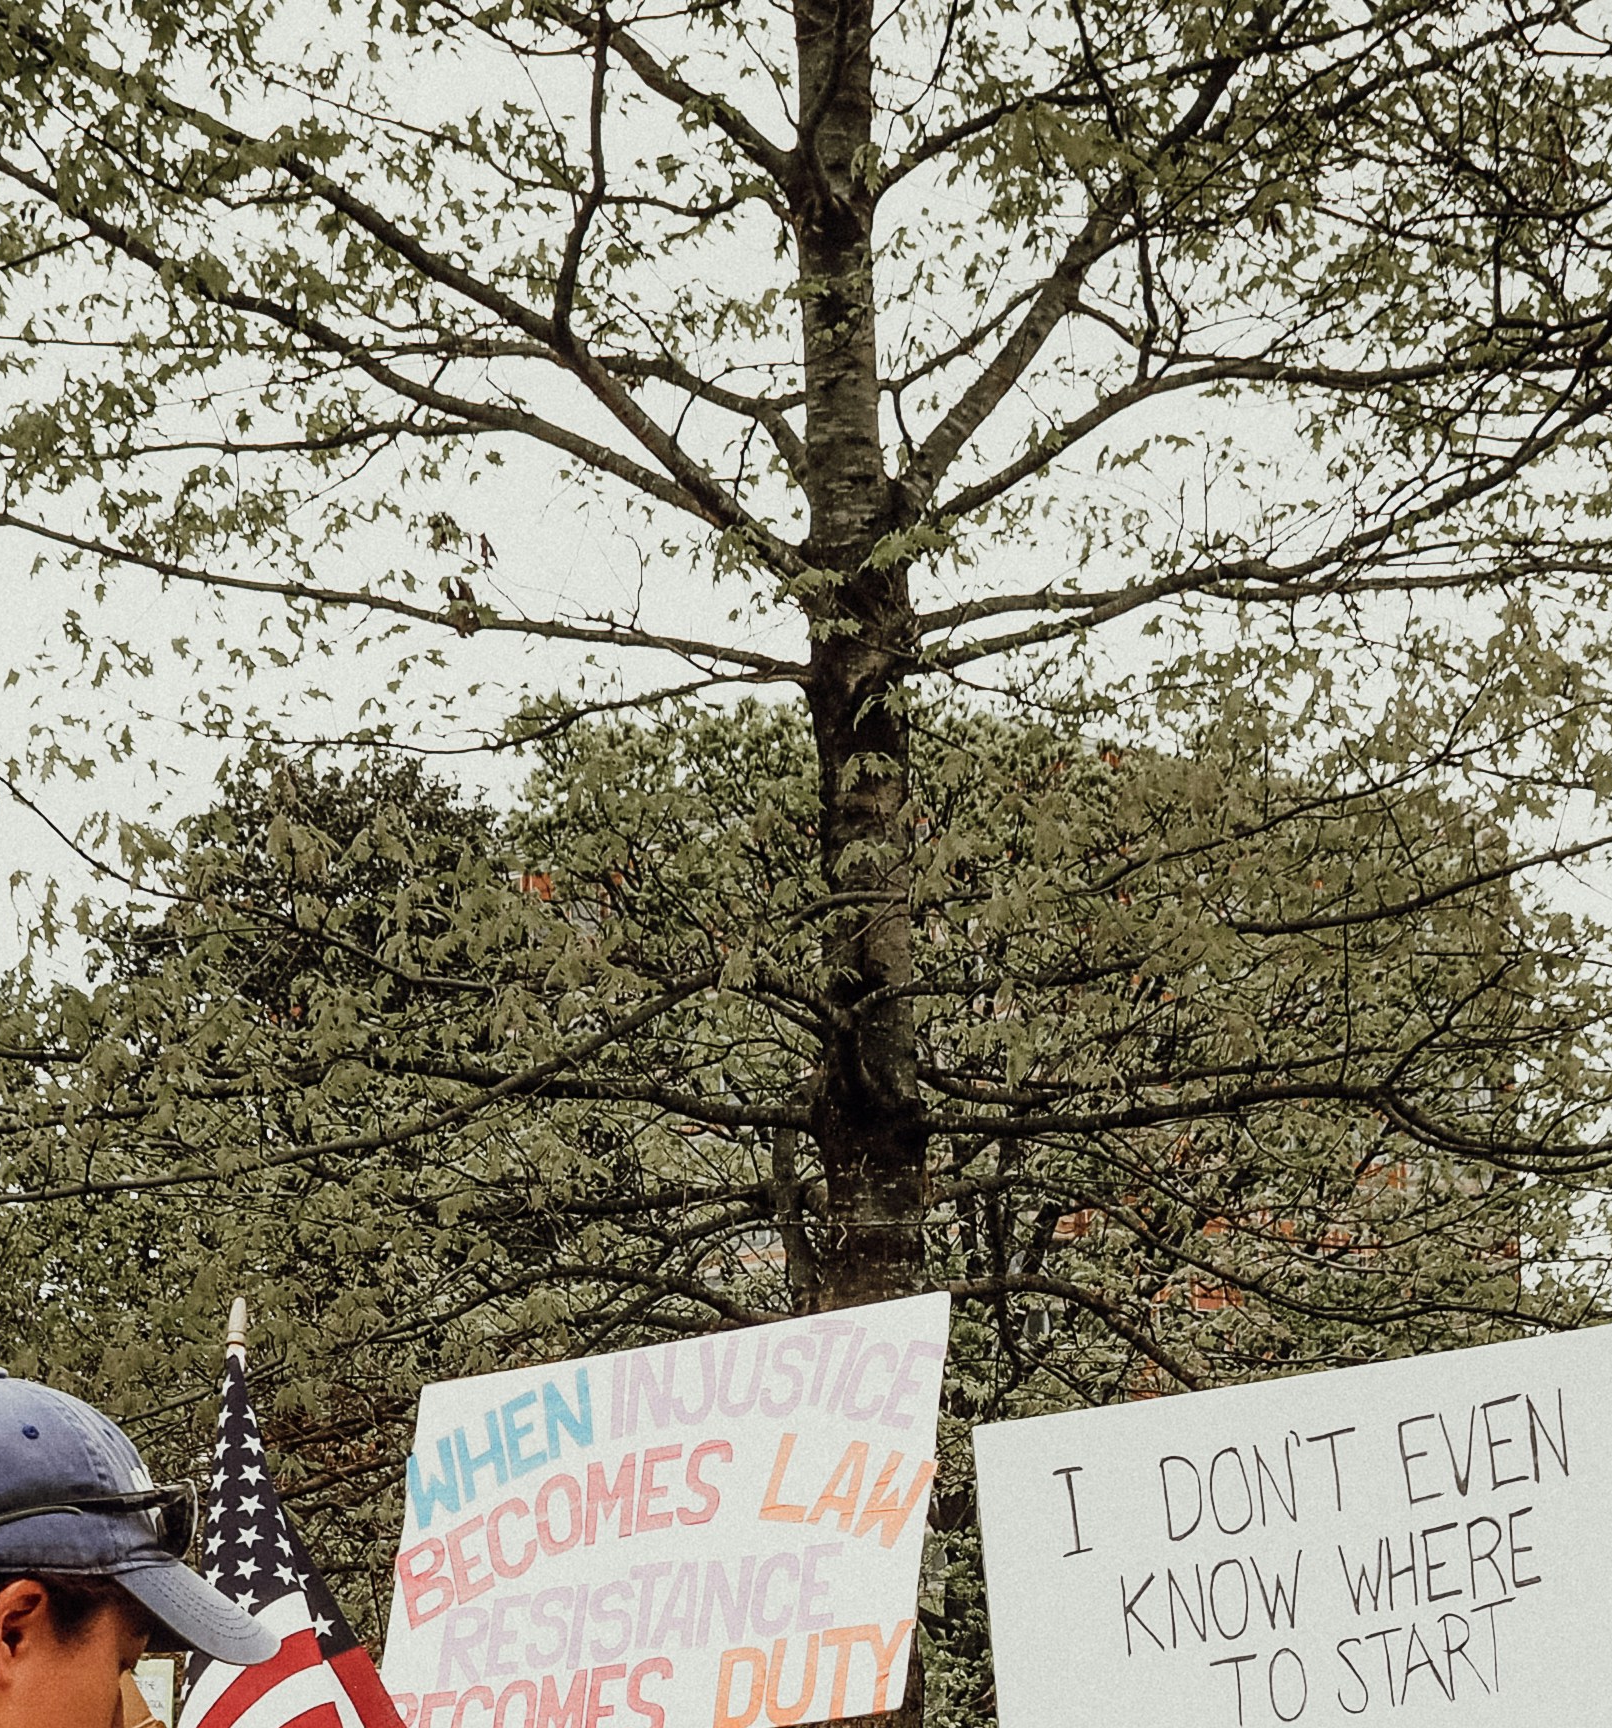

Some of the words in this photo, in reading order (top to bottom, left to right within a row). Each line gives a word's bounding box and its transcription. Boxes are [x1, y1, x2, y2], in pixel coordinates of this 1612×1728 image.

[405, 1366, 595, 1530] WHEN
[609, 1318, 944, 1440] INJUSTICE
[1052, 1465, 1094, 1558] I
[1158, 1426, 1356, 1542] DON'T
[1397, 1387, 1570, 1506] EVEN
[395, 1439, 733, 1631] BECOMES
[757, 1432, 938, 1549] LAW
[1119, 1548, 1303, 1657] KNOW
[1337, 1505, 1542, 1616] WHERE
[435, 1542, 843, 1688] RESISTANCE
[1209, 1647, 1308, 1727] TO
[1336, 1596, 1518, 1715] START
